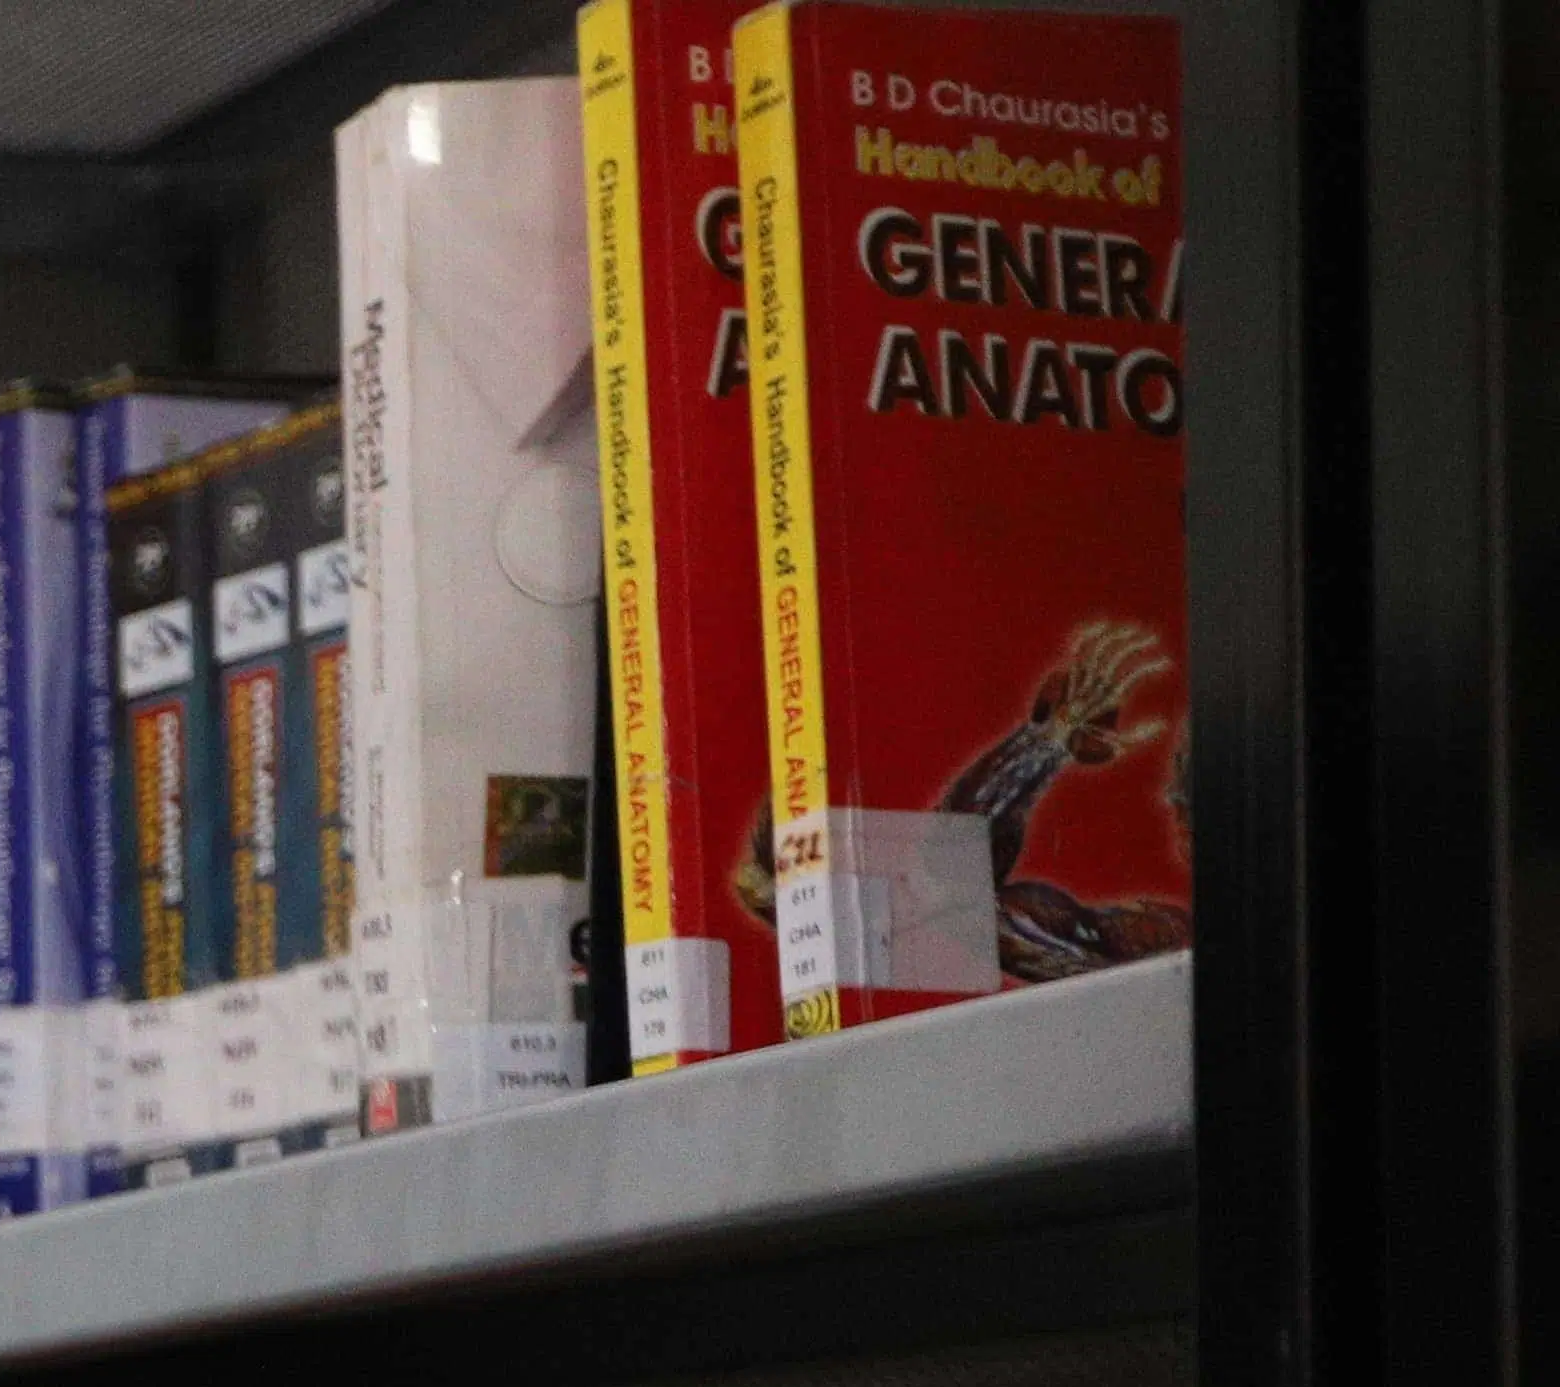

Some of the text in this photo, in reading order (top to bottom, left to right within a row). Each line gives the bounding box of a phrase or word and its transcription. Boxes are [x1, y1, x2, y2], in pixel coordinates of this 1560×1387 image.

[851, 70, 1169, 140] B D Chaurasia's
[854, 126, 1163, 204] Handbook of
[754, 177, 785, 361] Chaurasia's
[364, 300, 387, 491] Medical
[765, 377, 793, 538] Handbook
[598, 159, 653, 914] Chaurasia's Handbook of GENERAL ANATOMY
[775, 546, 796, 577] of
[776, 587, 804, 748] GENERAL
